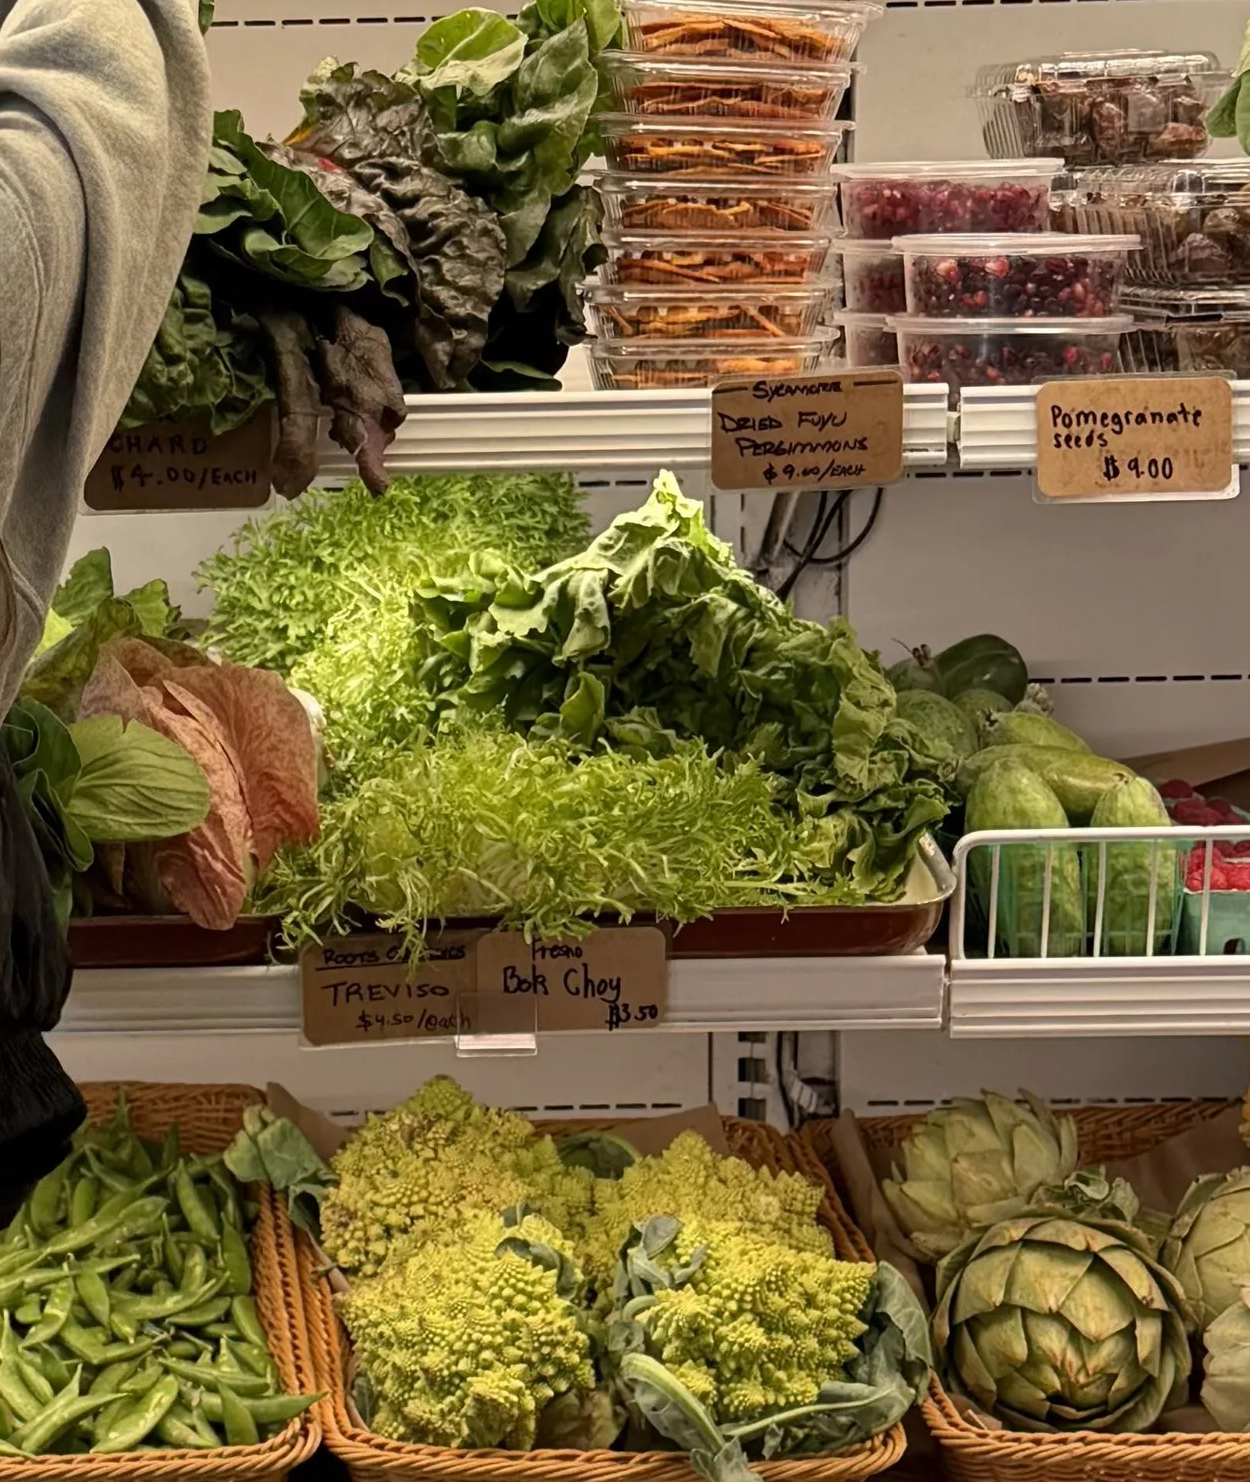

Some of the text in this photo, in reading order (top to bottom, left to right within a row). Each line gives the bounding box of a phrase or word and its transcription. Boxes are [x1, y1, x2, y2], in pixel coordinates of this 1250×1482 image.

[1051, 402, 1203, 435] Pomegranate
[1053, 430, 1109, 449] seeds
[321, 982, 450, 1007] TREVISO
[503, 963, 621, 1004] Bok Choy
